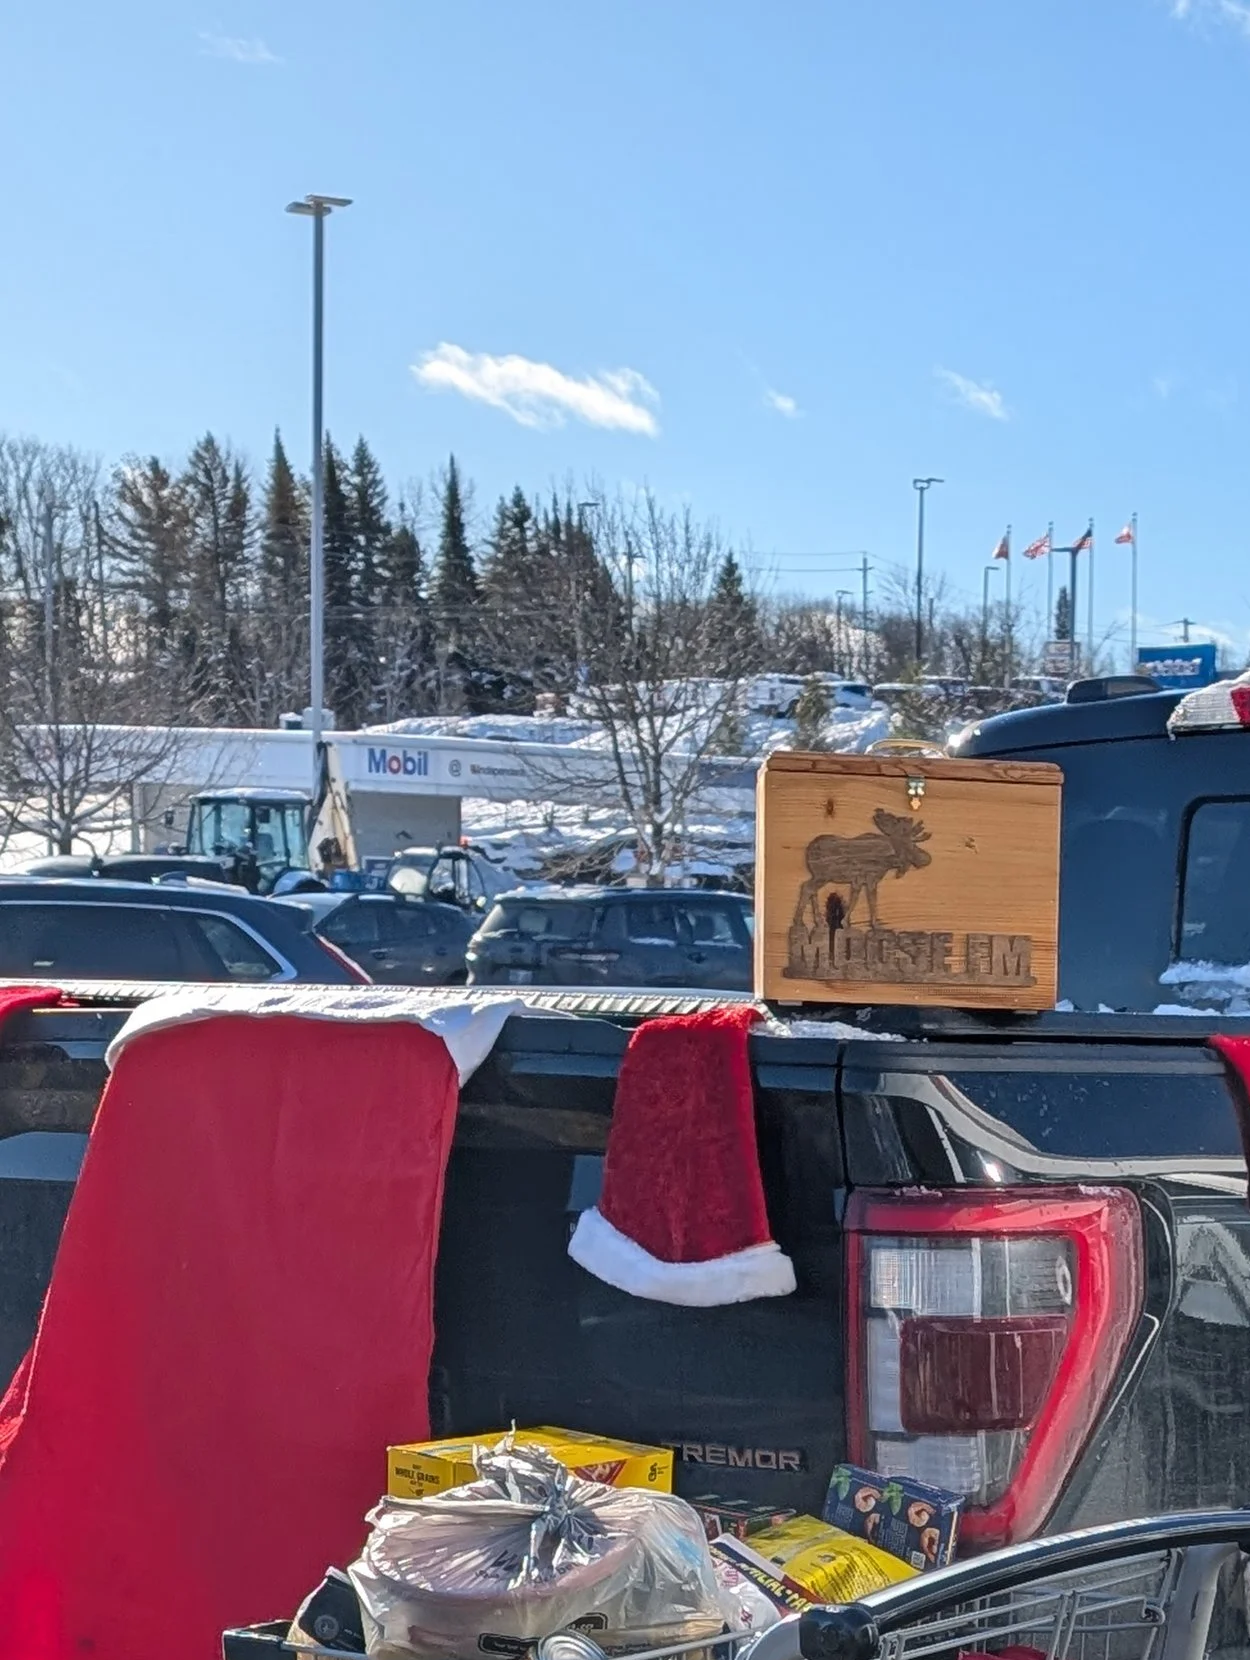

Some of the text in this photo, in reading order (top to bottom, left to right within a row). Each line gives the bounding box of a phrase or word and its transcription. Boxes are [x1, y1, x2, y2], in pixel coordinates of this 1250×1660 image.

[367, 747, 429, 777] Mobil
[449, 759, 462, 778] @
[787, 925, 1033, 978] MOOSE FM
